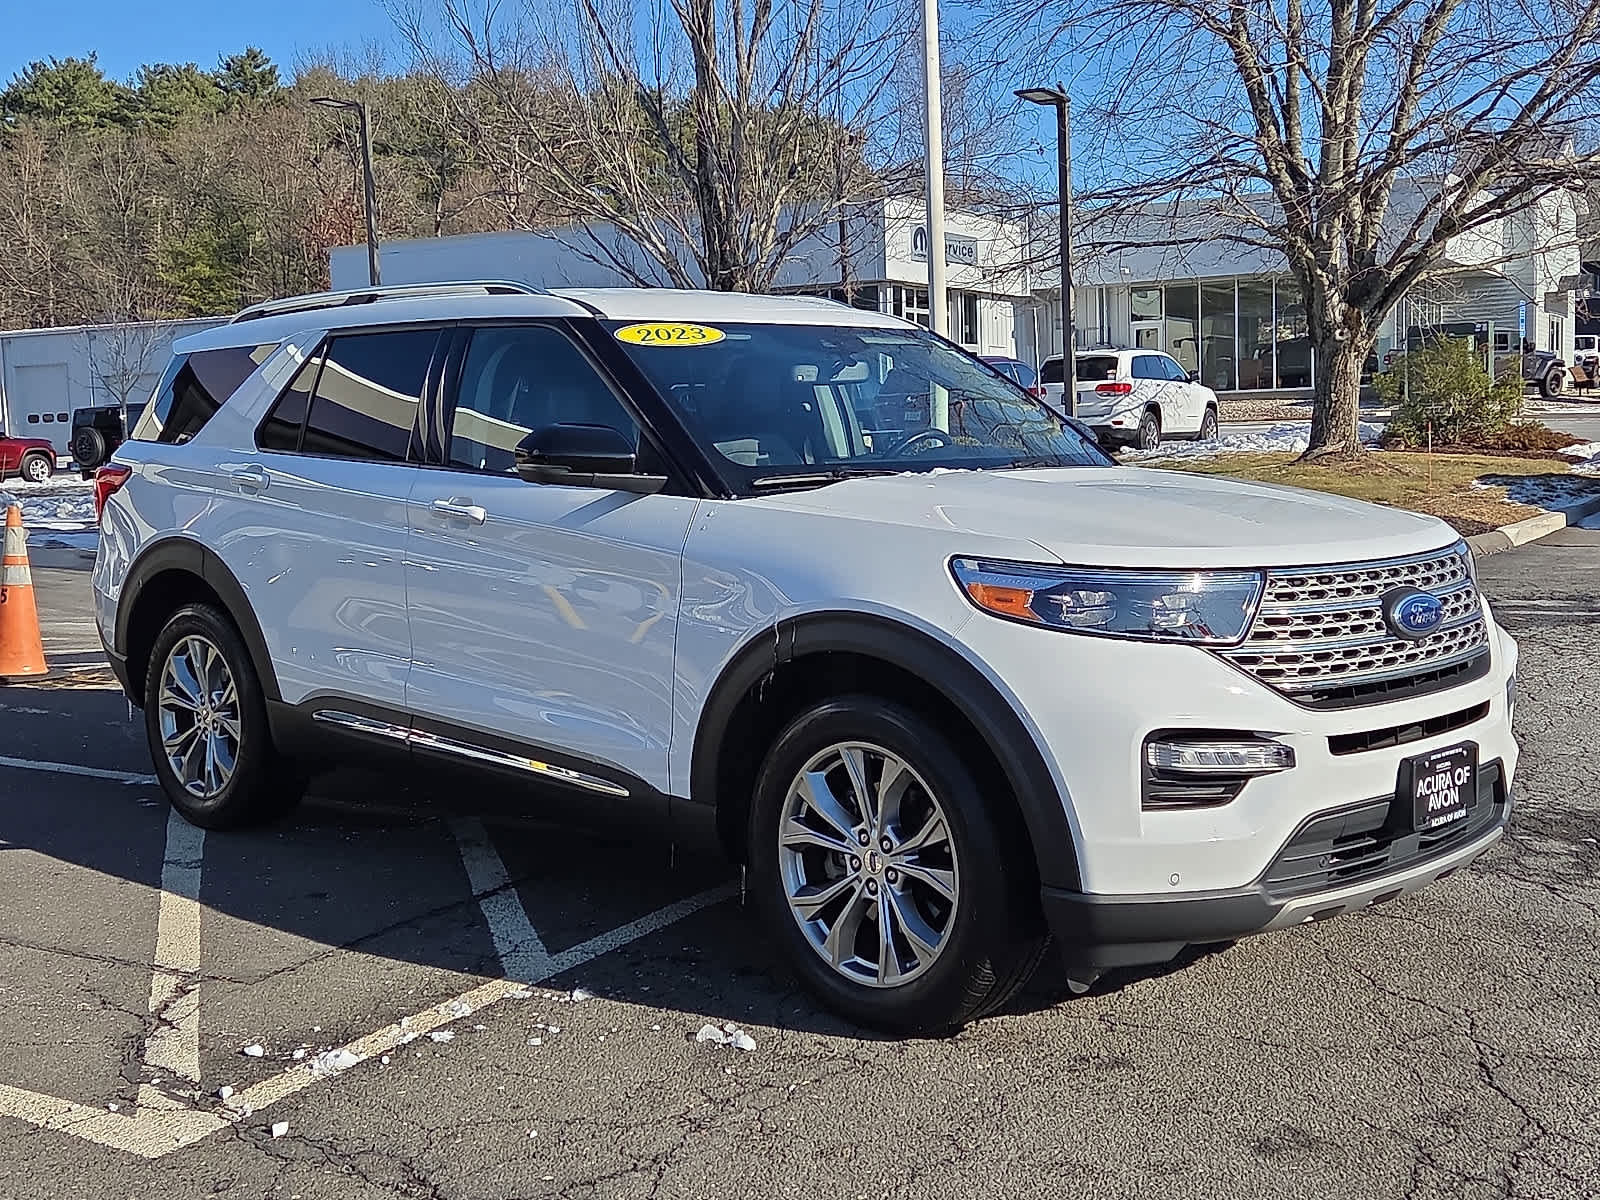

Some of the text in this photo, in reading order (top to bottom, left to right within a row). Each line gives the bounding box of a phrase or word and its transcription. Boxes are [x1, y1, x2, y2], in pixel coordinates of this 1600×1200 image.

[945, 241, 974, 258] rvice
[637, 327, 706, 342] 2023
[1410, 602, 1437, 626] Ford
[1416, 765, 1471, 798] ACURA OF
[1428, 786, 1460, 812] AVON
[1431, 808, 1467, 828] ACURA OF AVON
